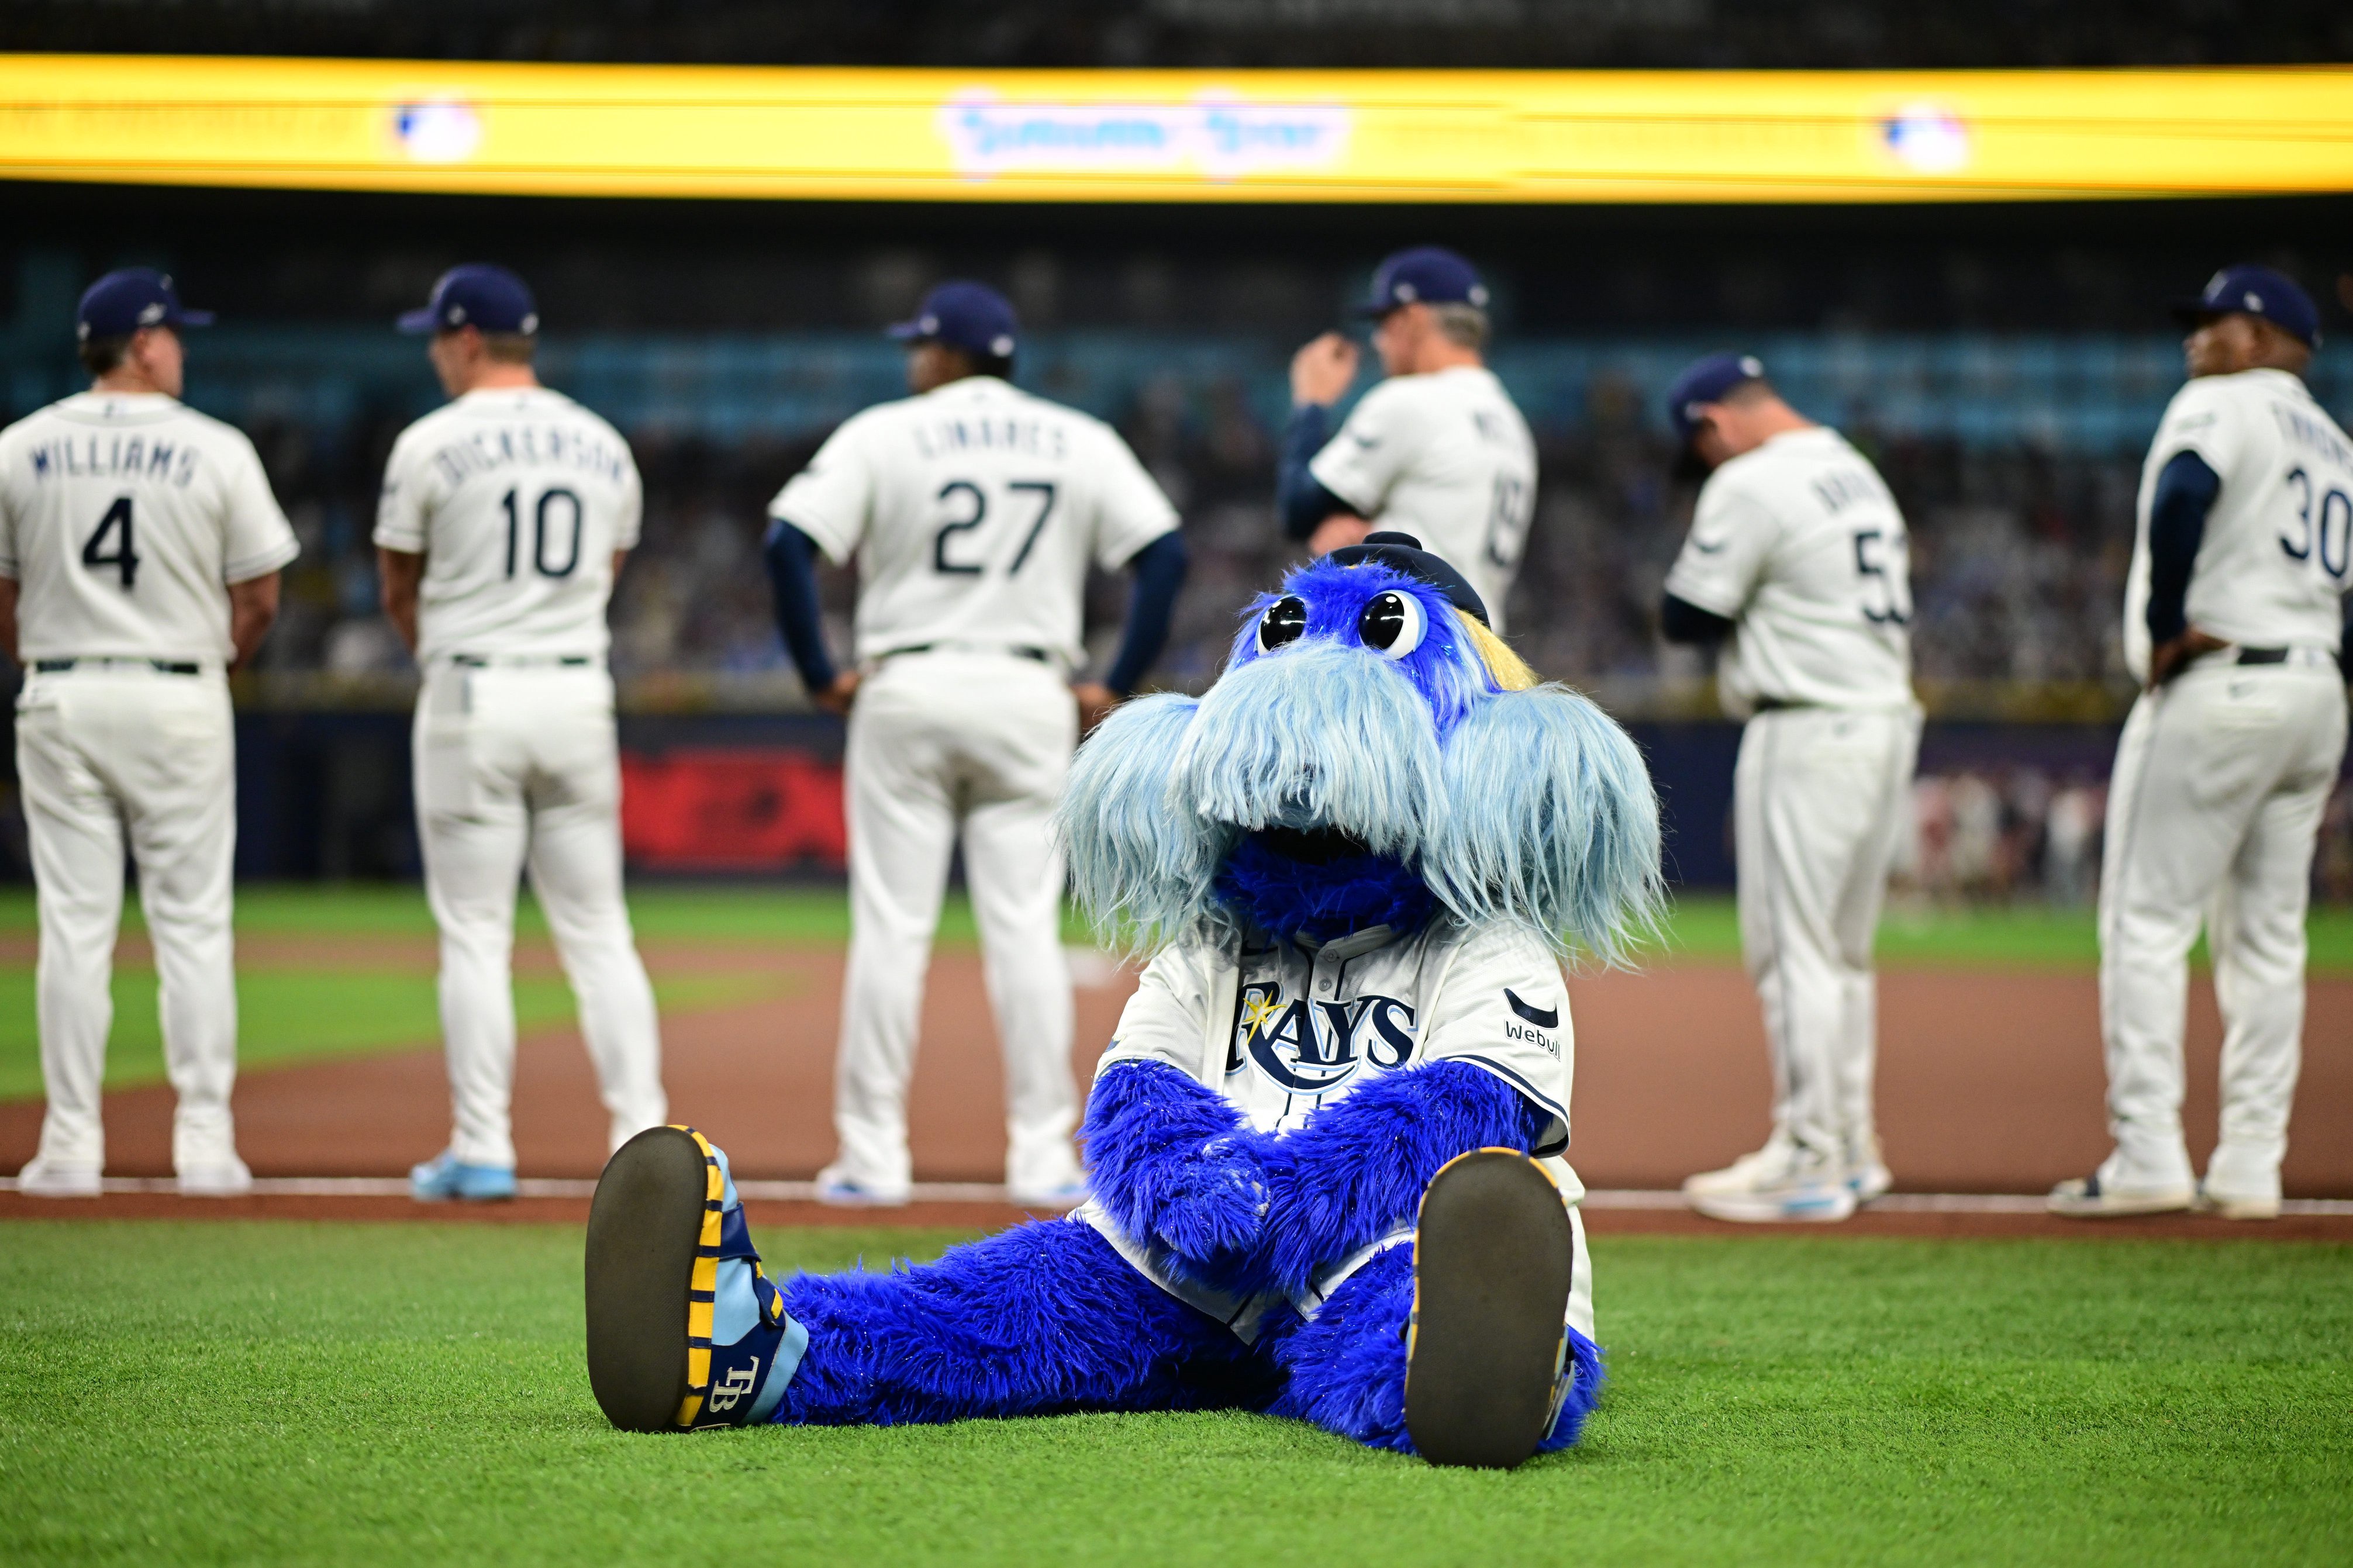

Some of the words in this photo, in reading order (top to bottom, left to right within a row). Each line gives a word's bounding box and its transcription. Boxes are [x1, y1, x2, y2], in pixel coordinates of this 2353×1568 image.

[30, 435, 201, 487] WILLIAMS
[913, 417, 1068, 460] LINARES
[82, 495, 140, 592] 4
[503, 487, 581, 578] 10
[933, 479, 1057, 579] 27
[2278, 468, 2352, 579] 30
[1226, 980, 1419, 1095] RAYS
[1505, 1020, 1560, 1060] Webull
[709, 1355, 760, 1412] TB
